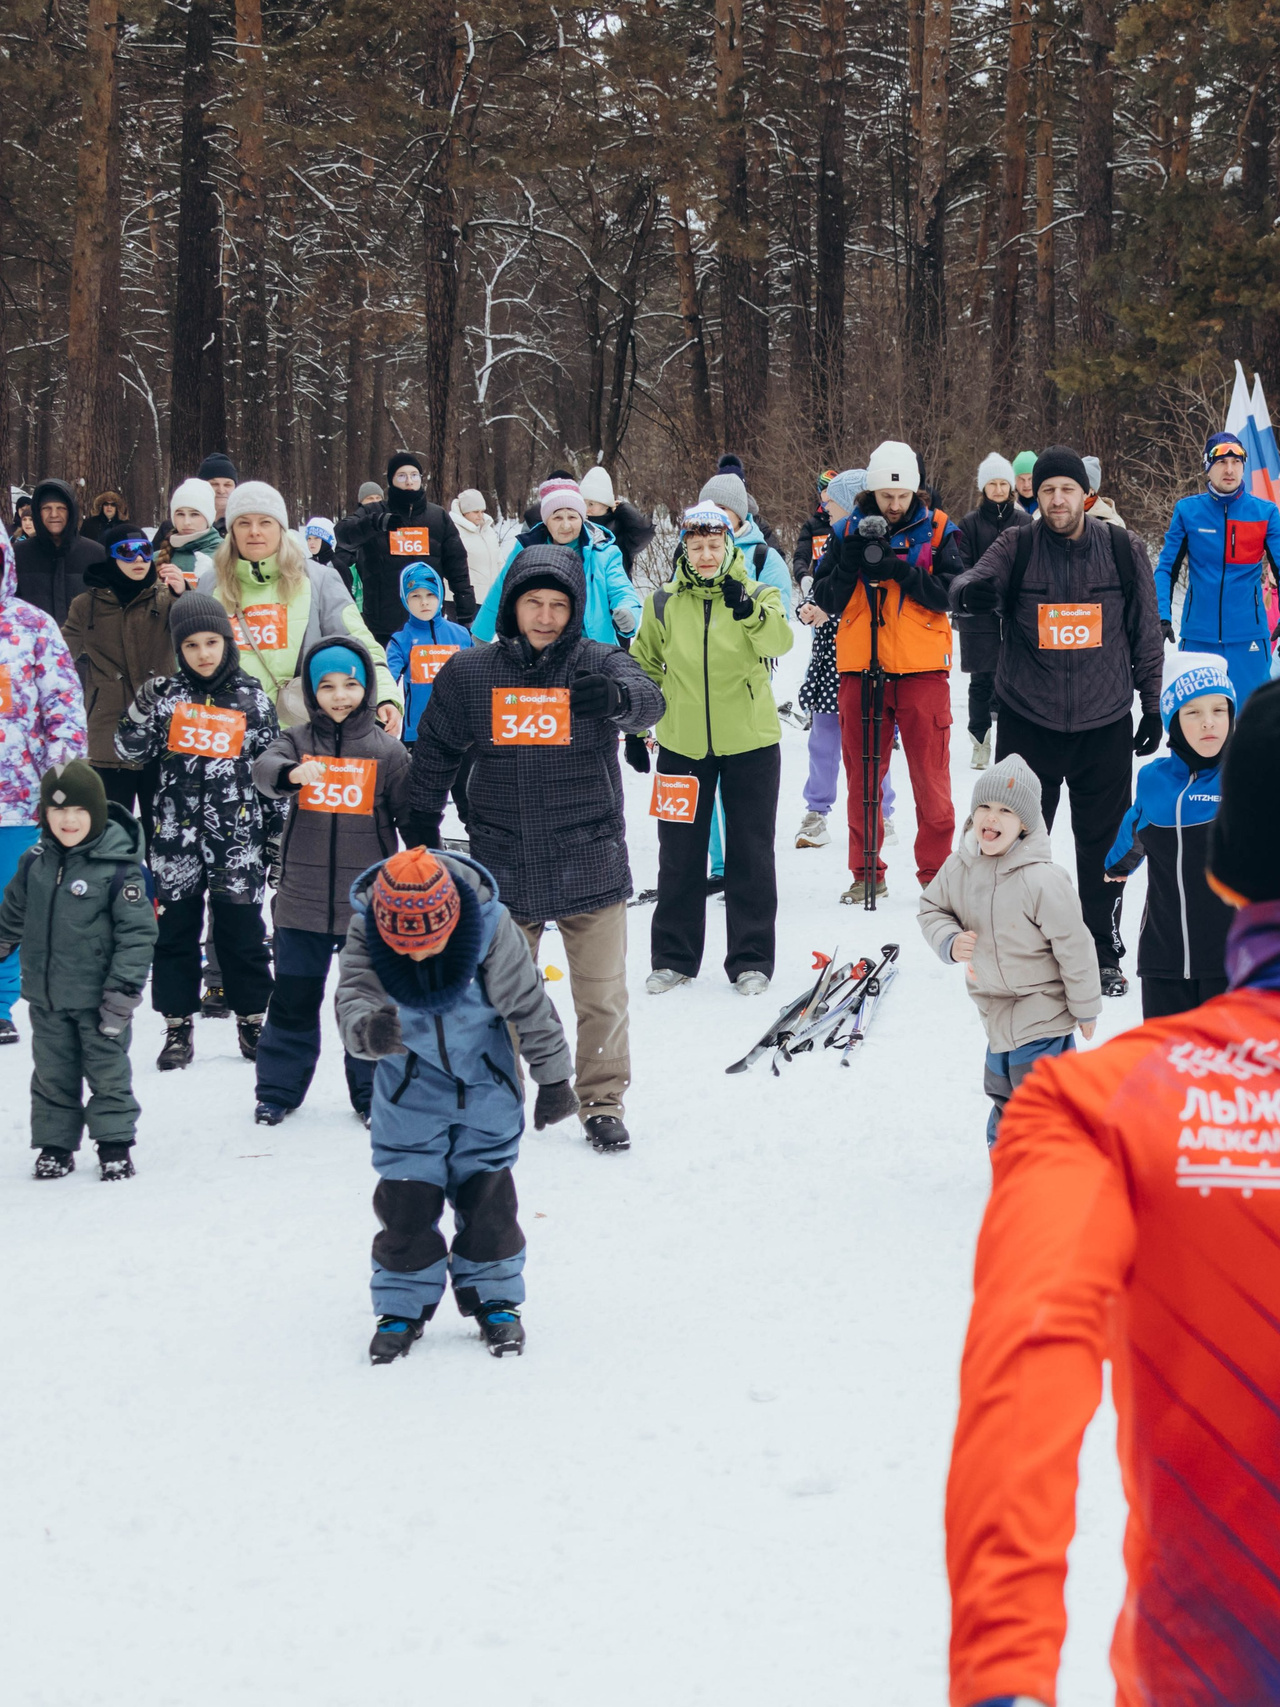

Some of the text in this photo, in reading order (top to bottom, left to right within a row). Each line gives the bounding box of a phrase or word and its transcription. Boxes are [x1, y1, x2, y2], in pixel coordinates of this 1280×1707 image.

[397, 540, 423, 552] 166
[247, 609, 278, 617] Goodline
[233, 624, 278, 645] 336
[1049, 625, 1090, 645] 169
[420, 662, 446, 679] 13
[519, 694, 558, 703] Goodline
[200, 711, 237, 724] Goodline
[501, 713, 558, 739] 349
[178, 725, 232, 753] 338
[329, 764, 365, 774] Goodline
[307, 781, 364, 807] 350
[656, 794, 690, 816] 342
